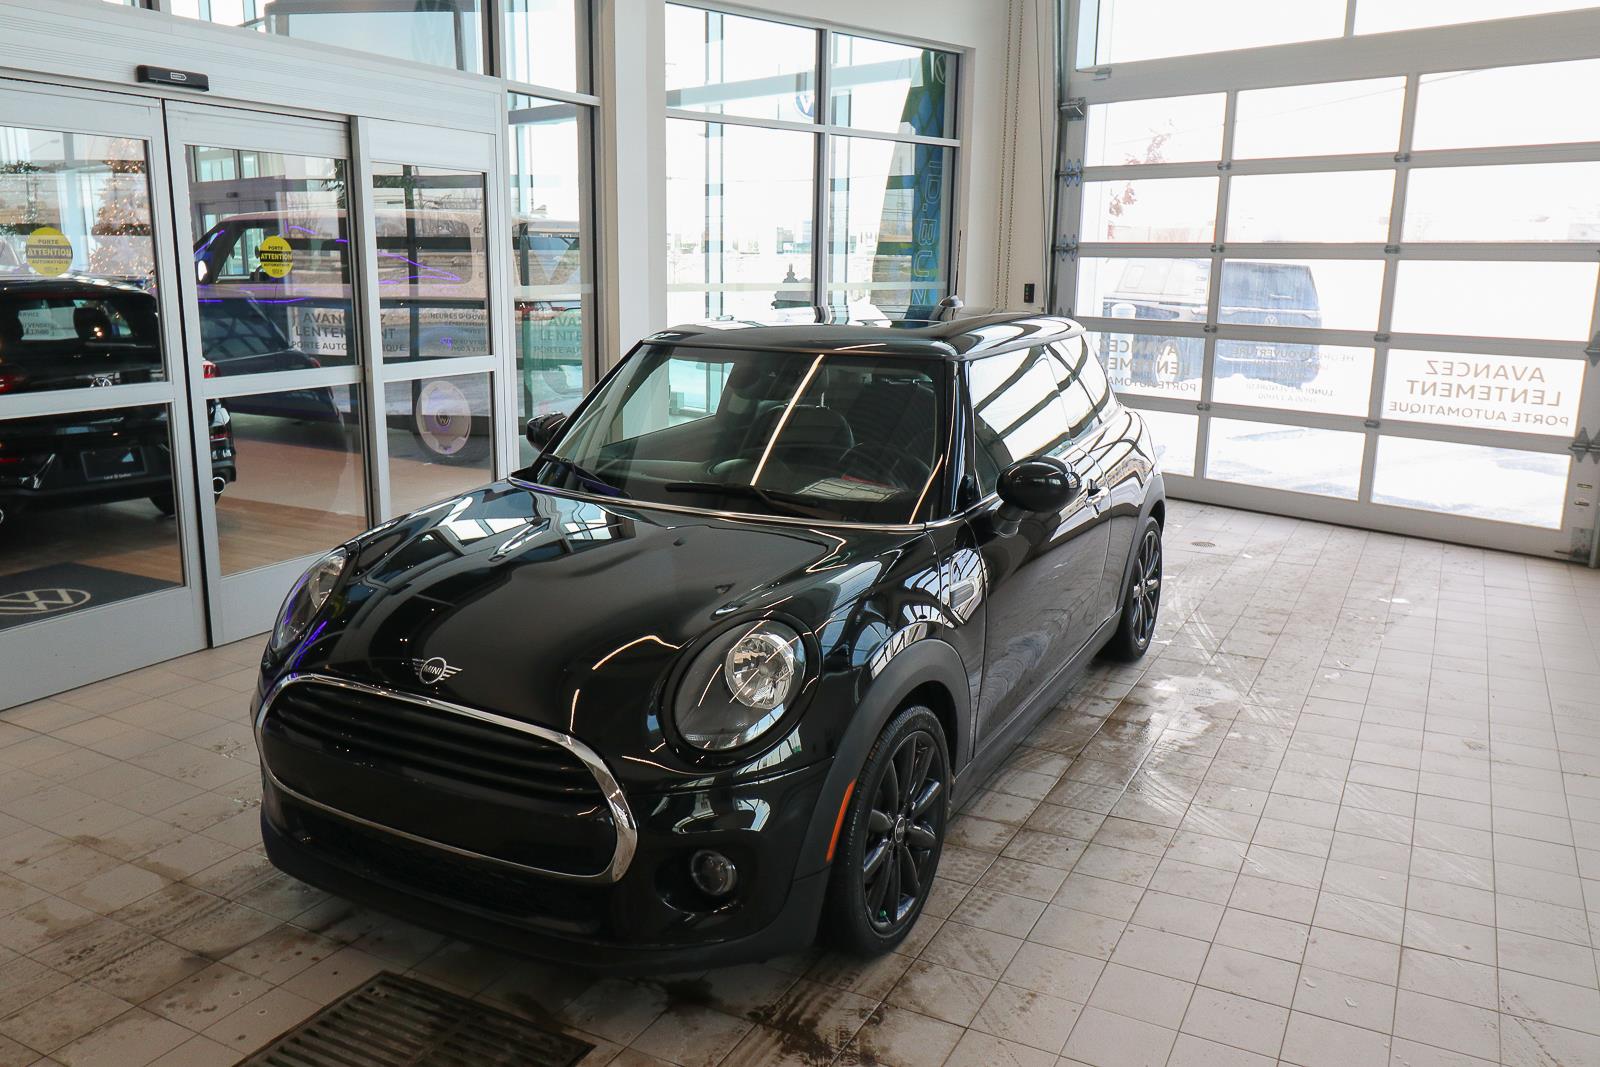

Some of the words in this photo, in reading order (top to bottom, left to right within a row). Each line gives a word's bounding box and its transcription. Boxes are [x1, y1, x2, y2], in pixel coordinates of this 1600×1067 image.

[27, 247, 72, 257] ATTENTION
[260, 253, 293, 261] ATTENTION
[423, 664, 443, 675] MINI
